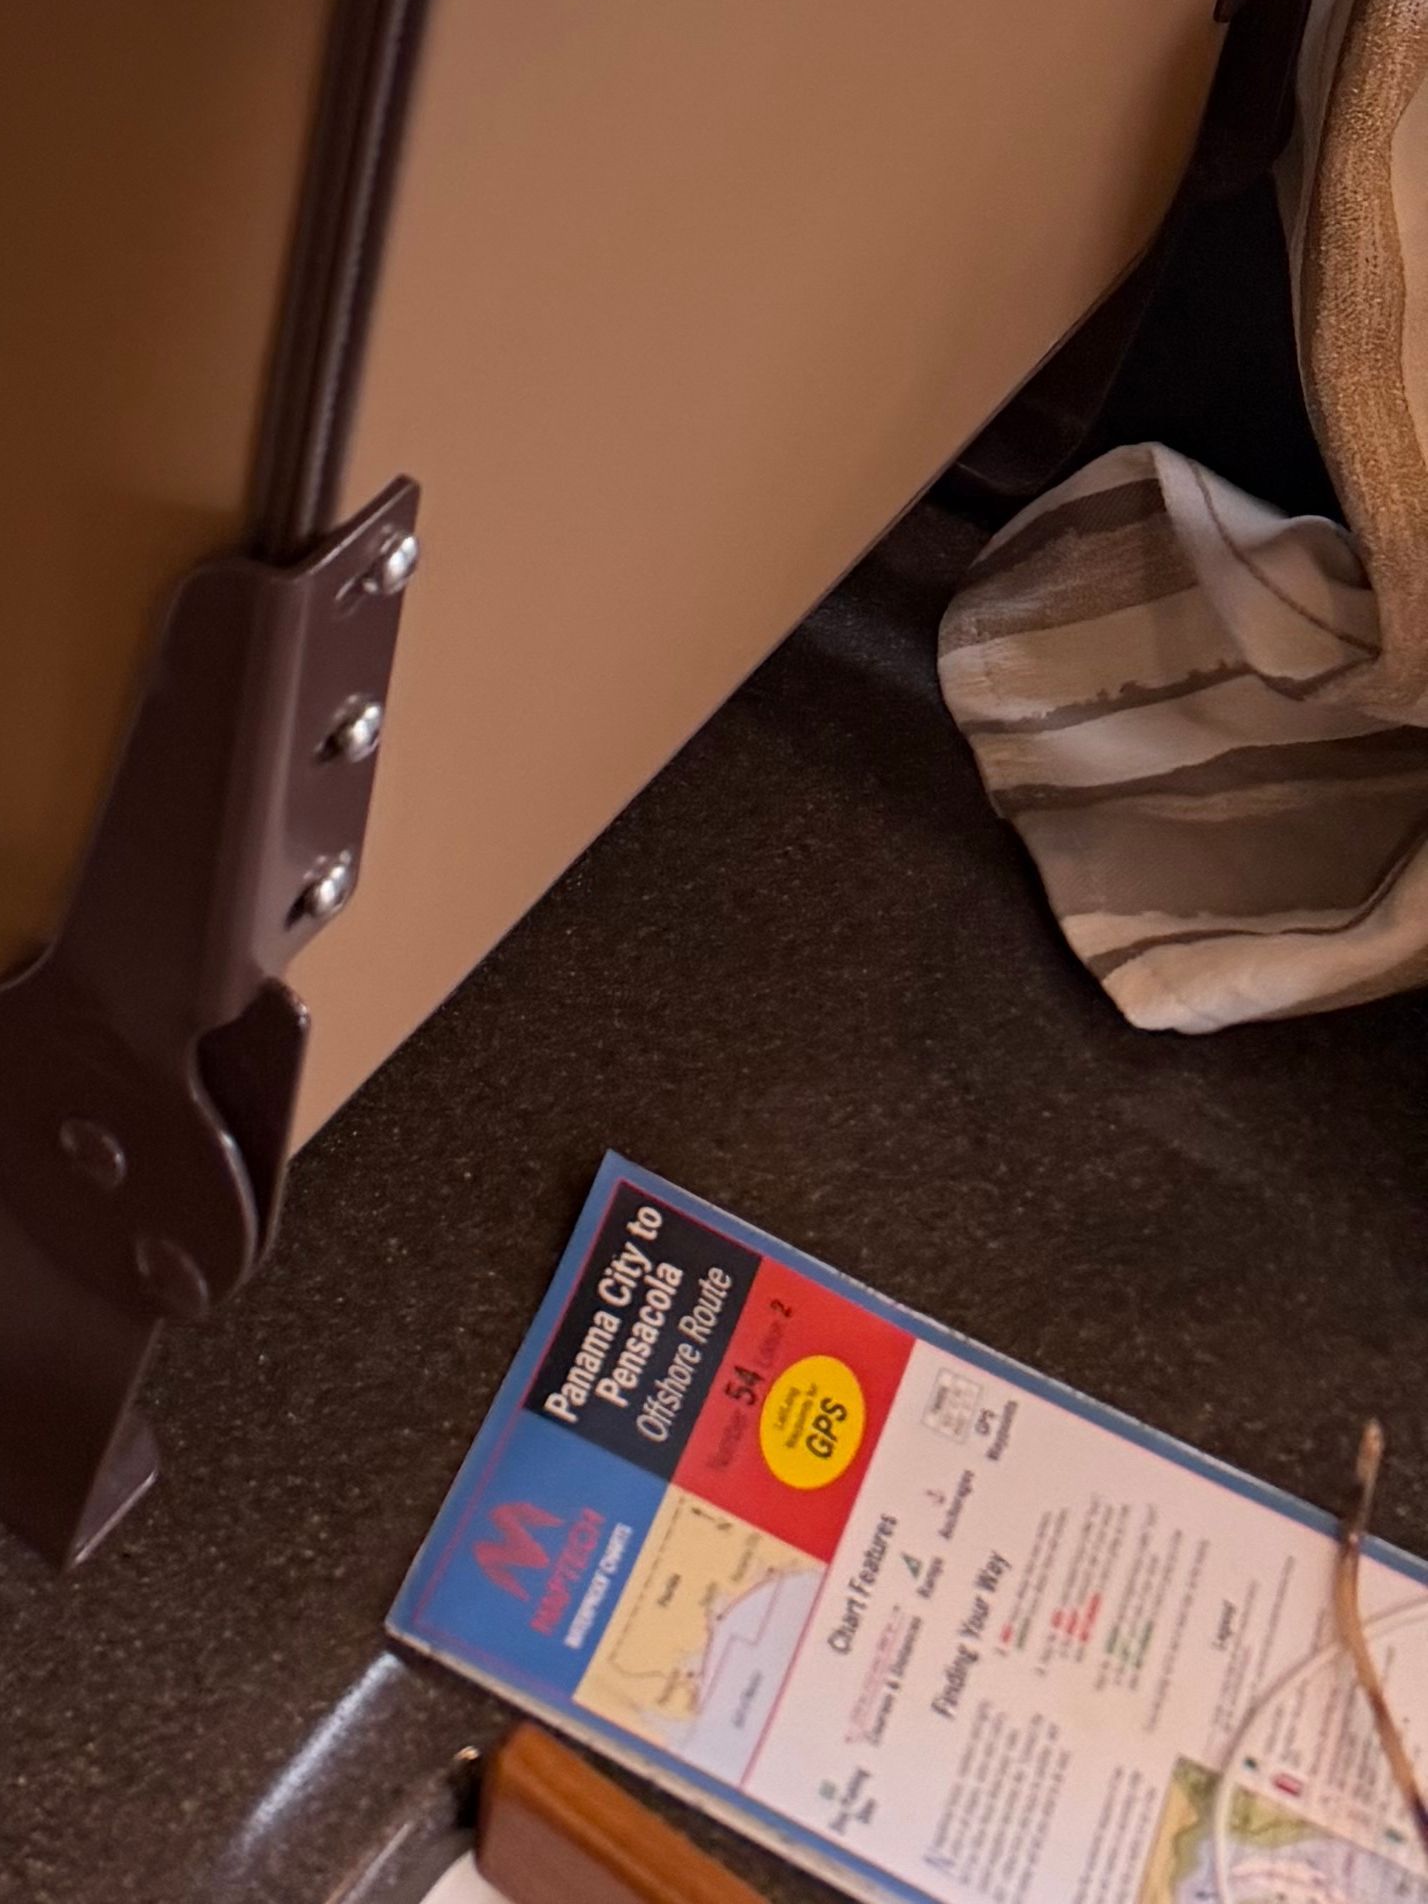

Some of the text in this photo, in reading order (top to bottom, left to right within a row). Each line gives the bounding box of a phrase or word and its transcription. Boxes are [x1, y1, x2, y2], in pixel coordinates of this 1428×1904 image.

[543, 1205, 664, 1424] Panama City to
[595, 1260, 684, 1407] Pensacola
[636, 1341, 704, 1442] Offshore
[680, 1267, 733, 1341] Route
[725, 1366, 764, 1405] 54
[771, 1300, 794, 1317] 2
[805, 1397, 849, 1459] GPS
[828, 1514, 896, 1654] Chart Features
[933, 1549, 1013, 1720] Finding Your Way
